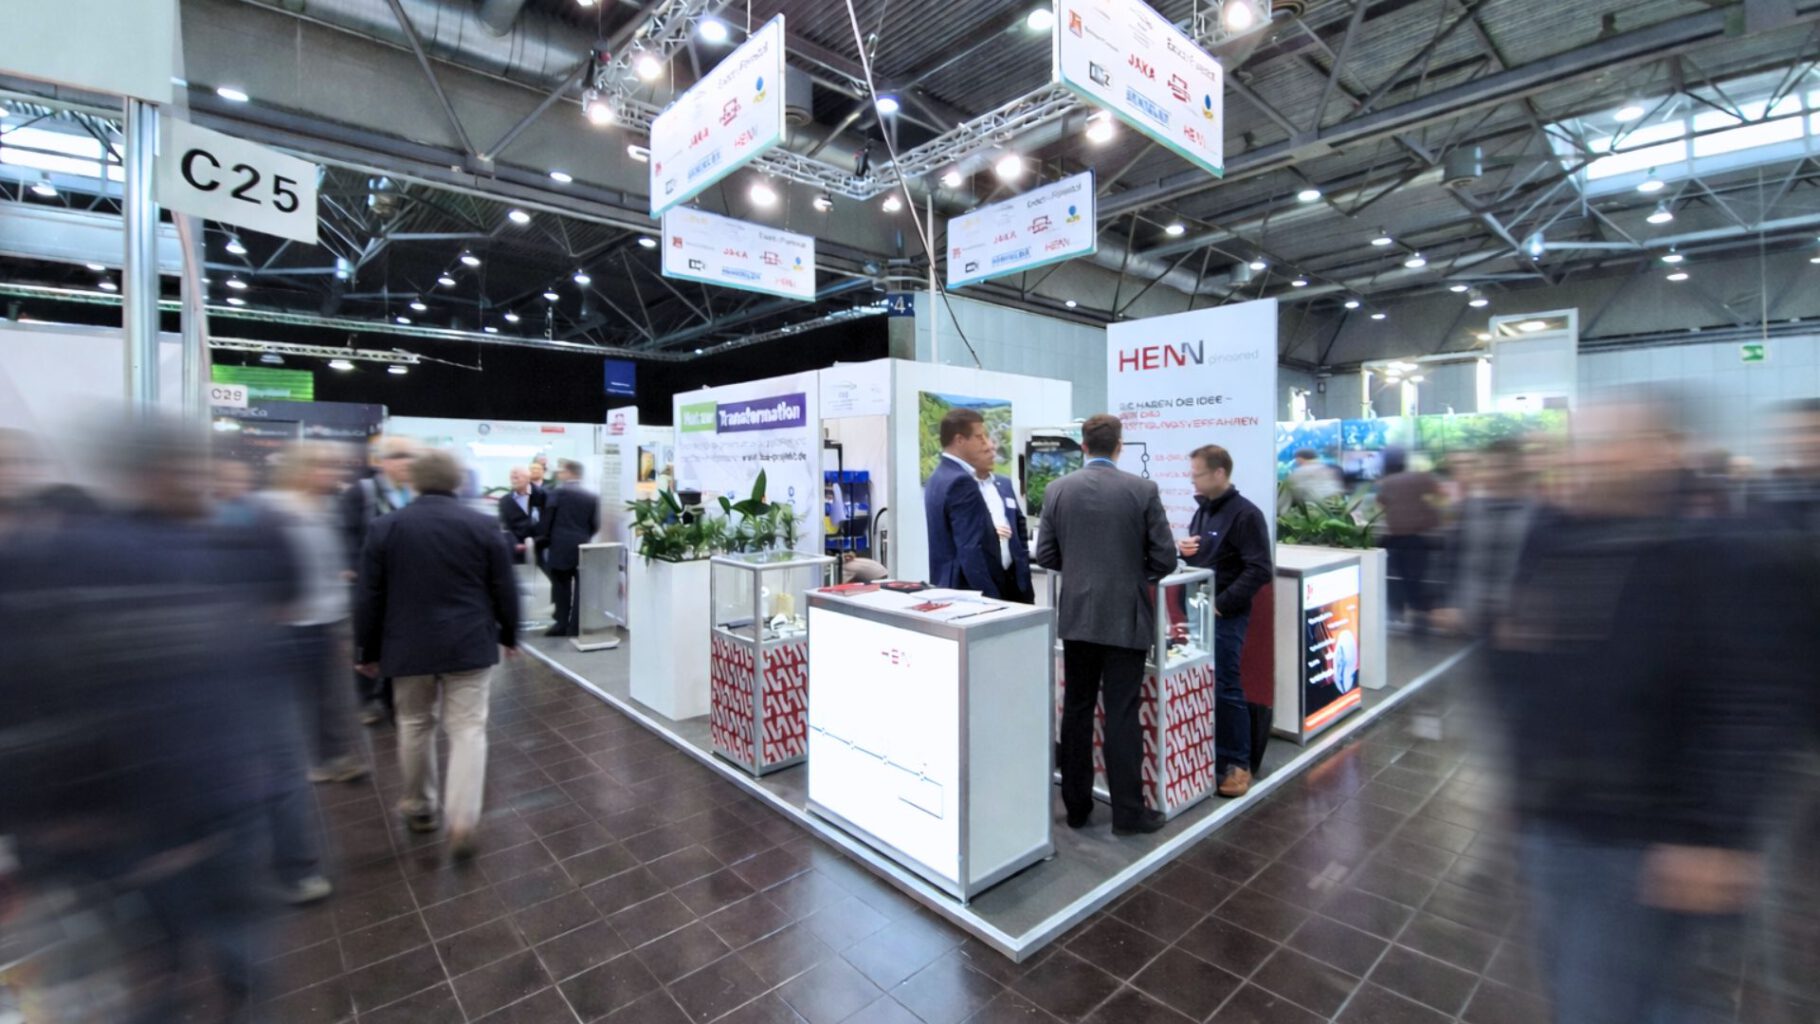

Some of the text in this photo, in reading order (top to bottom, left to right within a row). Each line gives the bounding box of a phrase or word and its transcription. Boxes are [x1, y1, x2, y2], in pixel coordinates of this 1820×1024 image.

[180, 147, 300, 214] C25
[894, 295, 906, 314] 4
[1118, 339, 1204, 373] HENN
[1196, 395, 1223, 405] IDEE
[718, 401, 801, 427] Transformation
